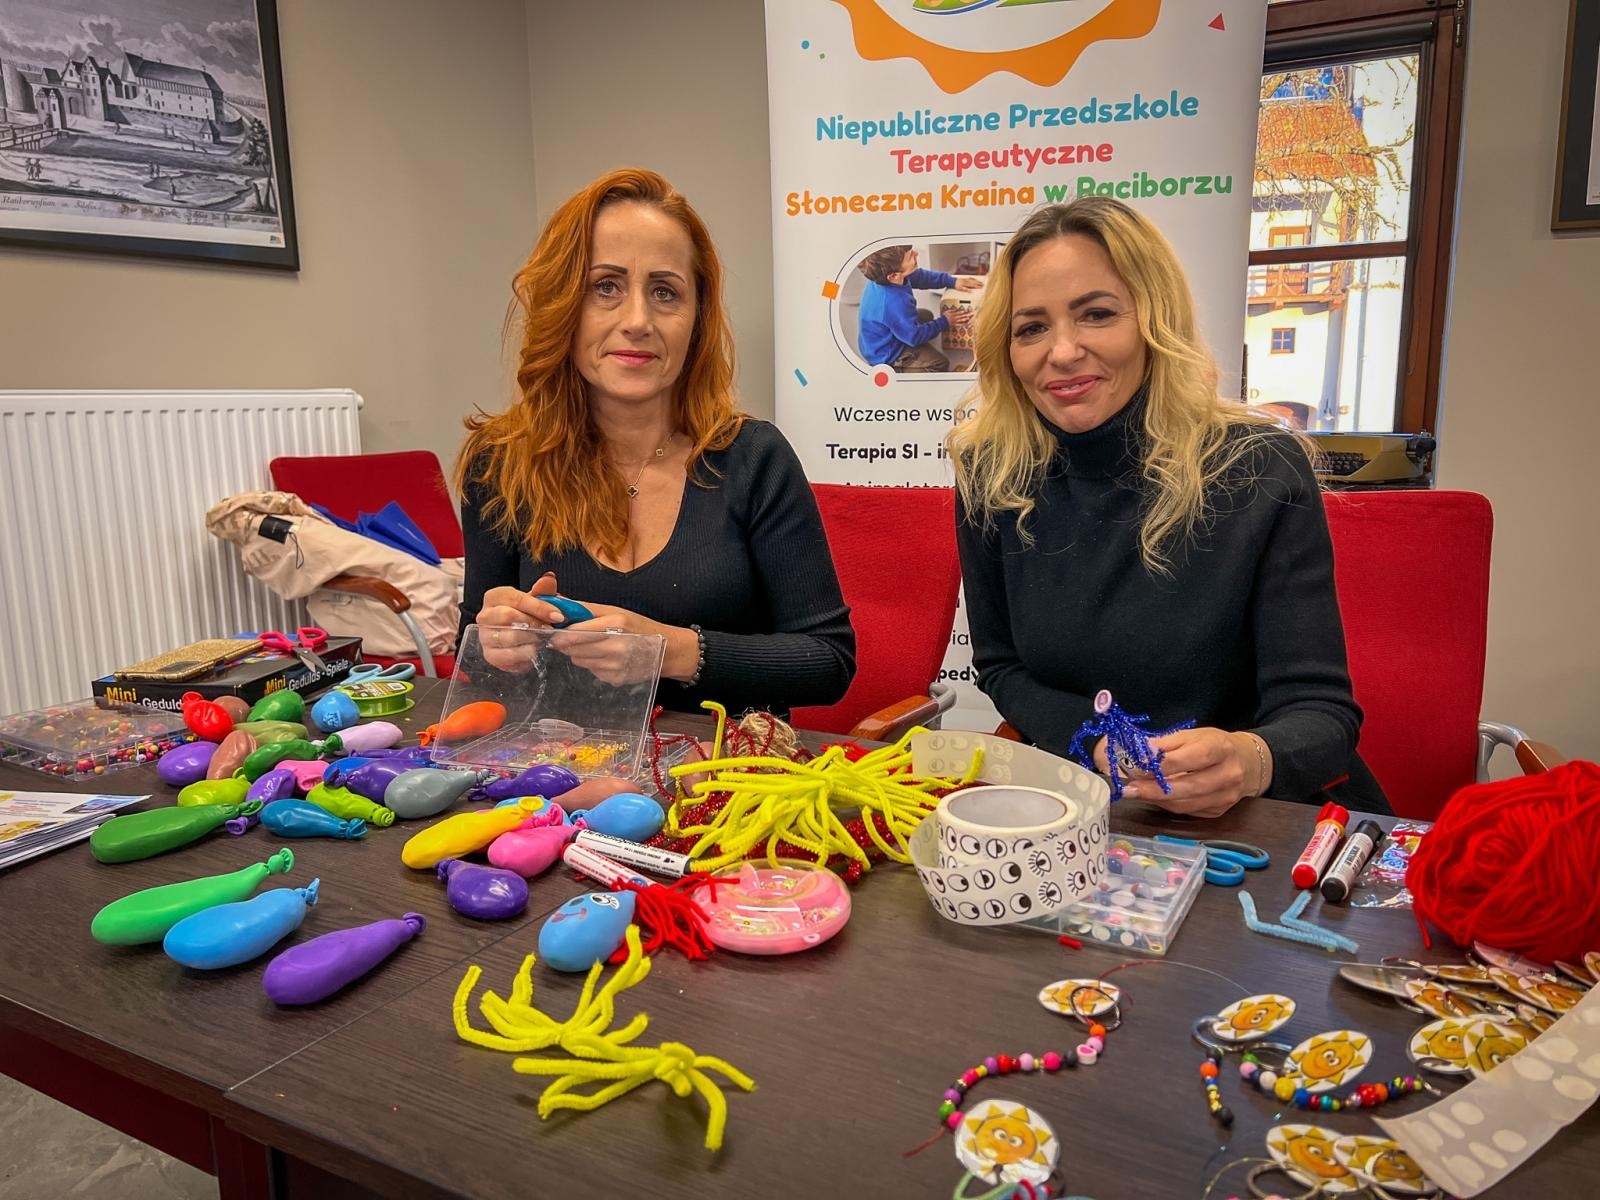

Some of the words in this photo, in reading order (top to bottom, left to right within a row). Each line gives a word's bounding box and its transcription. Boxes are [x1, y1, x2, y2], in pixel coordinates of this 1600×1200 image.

[816, 109, 1001, 146] Niepubliczne
[1009, 90, 1199, 129] Przedszkole
[890, 143, 1114, 178] Terapeutyczne
[786, 190, 933, 216] Słoneczna
[941, 180, 1035, 209] Kraina
[1043, 184, 1068, 203] w
[1076, 171, 1233, 199] Raciborzu
[833, 406, 921, 422] Wczesne
[825, 442, 897, 464] Terapia
[902, 443, 918, 459] SI
[106, 686, 137, 706] Mini
[264, 674, 286, 696] Mini
